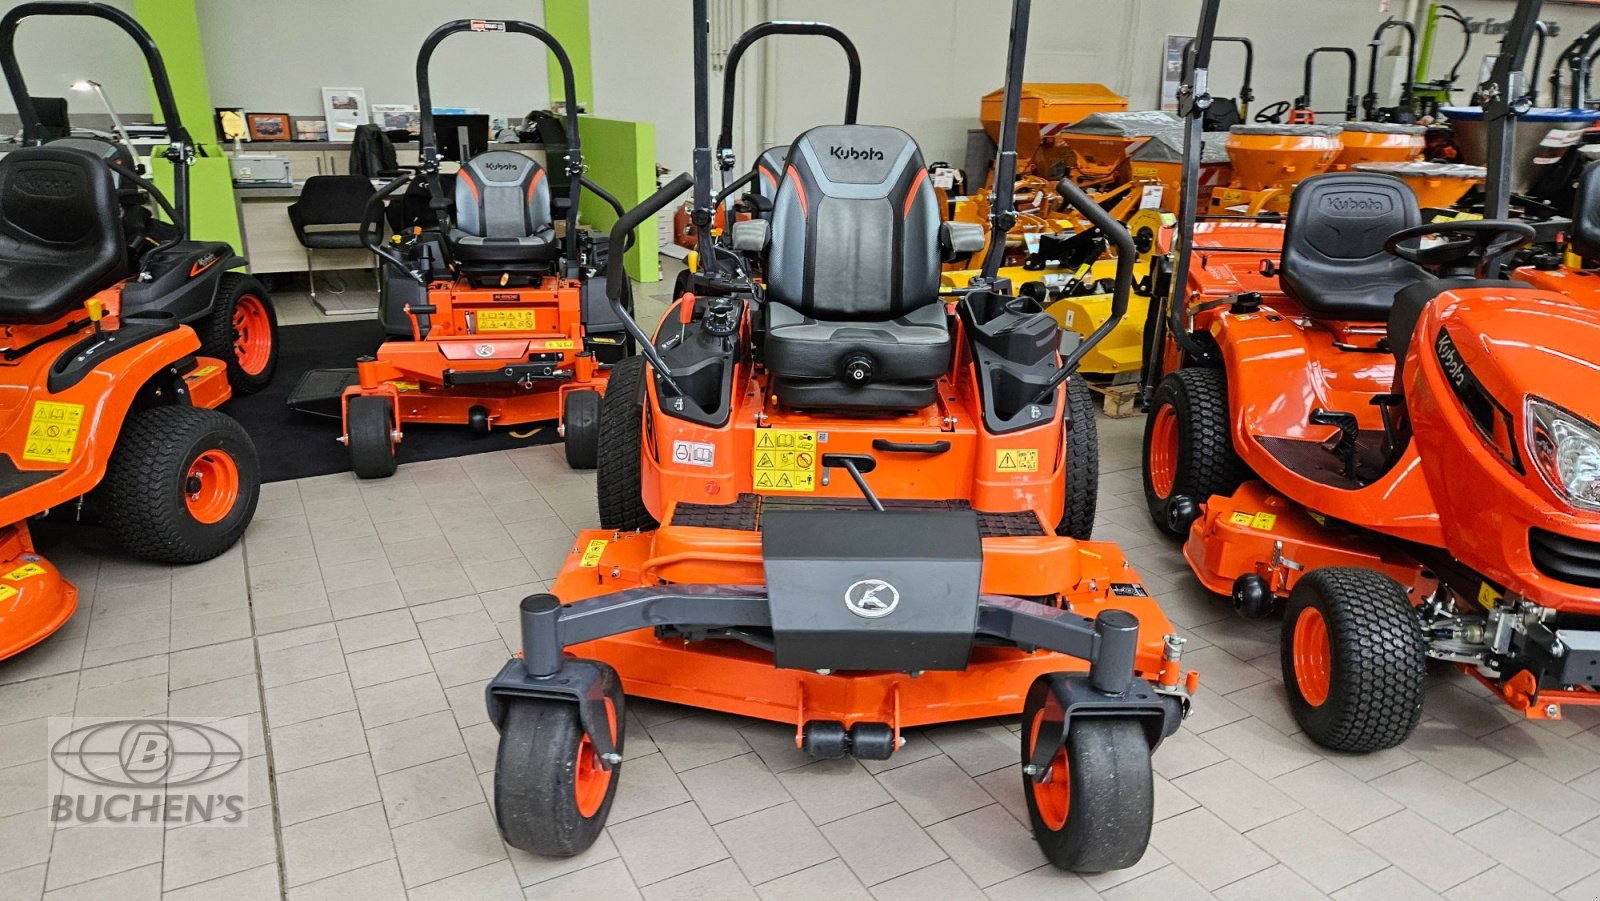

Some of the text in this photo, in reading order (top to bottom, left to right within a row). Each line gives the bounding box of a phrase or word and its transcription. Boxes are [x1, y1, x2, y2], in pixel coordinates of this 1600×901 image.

[829, 145, 884, 161] Kubota
[485, 162, 518, 171] Kubota
[1327, 197, 1384, 212] Kubota
[1437, 334, 1465, 387] Kubota
